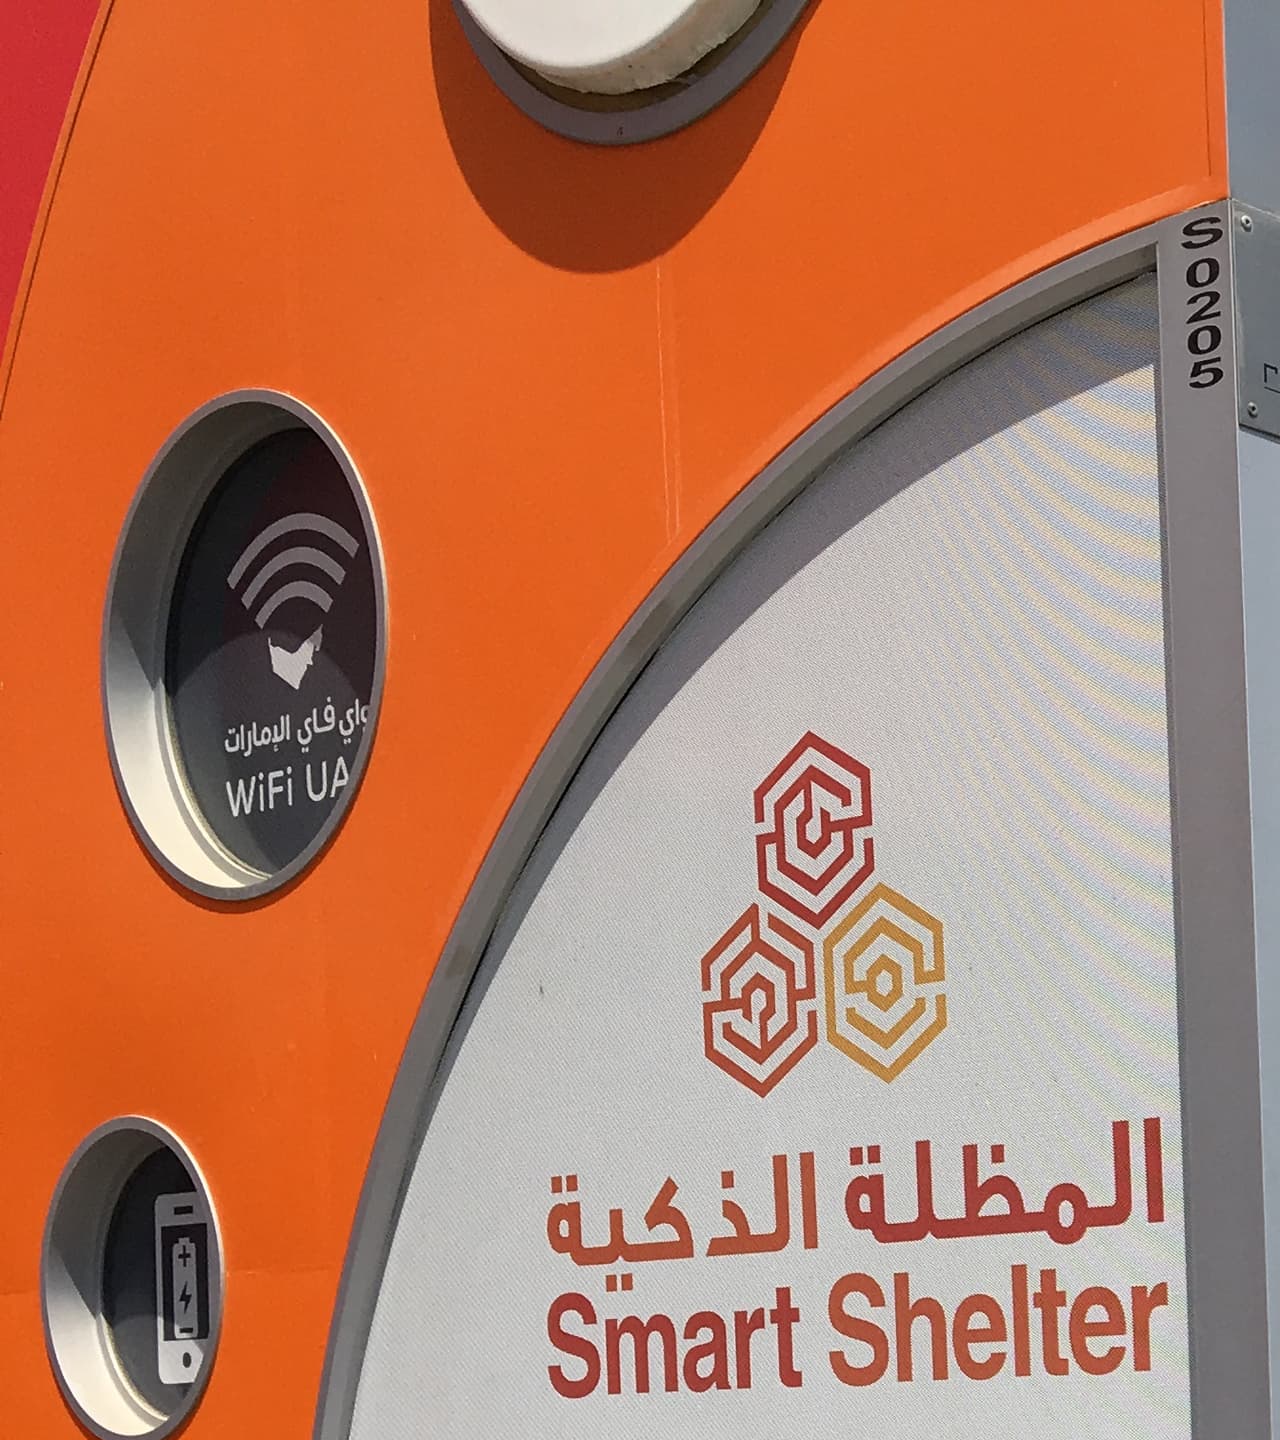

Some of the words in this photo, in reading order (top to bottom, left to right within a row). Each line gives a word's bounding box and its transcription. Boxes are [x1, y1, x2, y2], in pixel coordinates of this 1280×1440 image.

[225, 765, 293, 817] WiFi
[547, 1151, 818, 1293] الذكية
[844, 1117, 1164, 1245] المظلة
[547, 1287, 803, 1398] Smart
[828, 1264, 1168, 1387] Shelter
